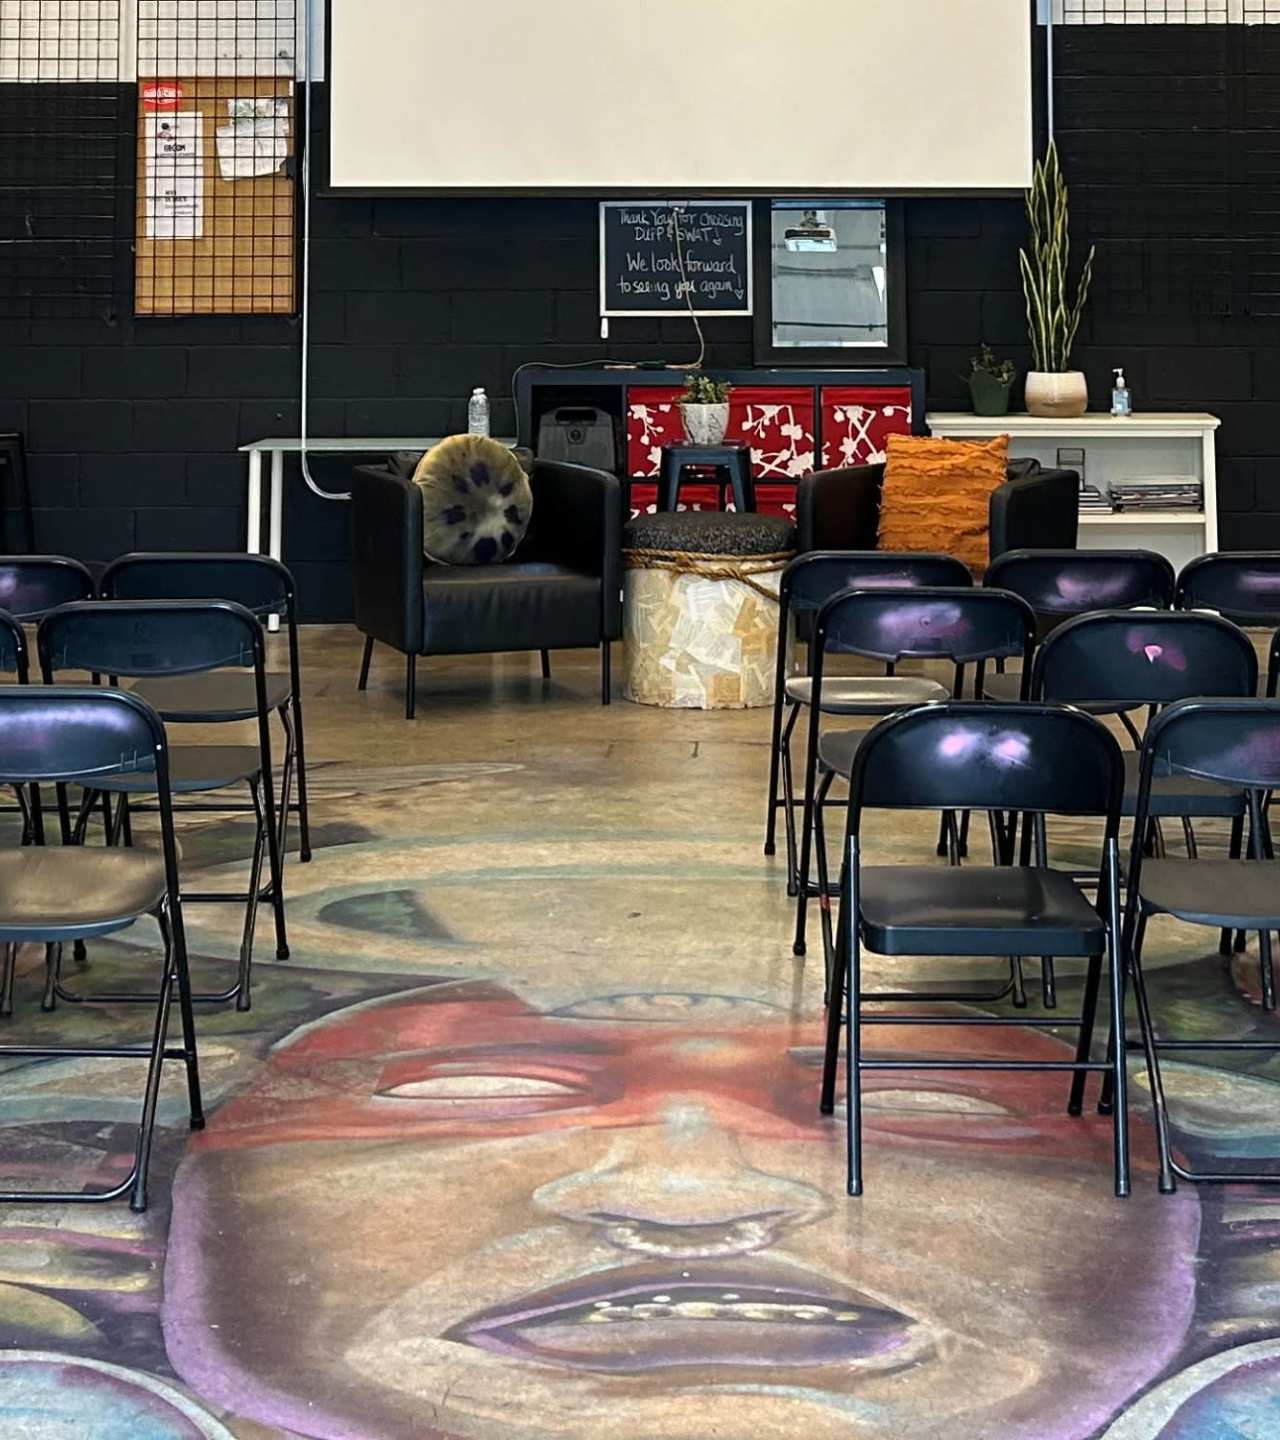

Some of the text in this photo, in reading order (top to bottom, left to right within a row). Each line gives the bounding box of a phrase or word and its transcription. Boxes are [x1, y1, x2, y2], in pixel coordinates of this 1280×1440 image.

[618, 209, 649, 225] Thank
[627, 249, 737, 273] We look forward
[617, 275, 631, 294] to
[674, 279, 696, 299] you
